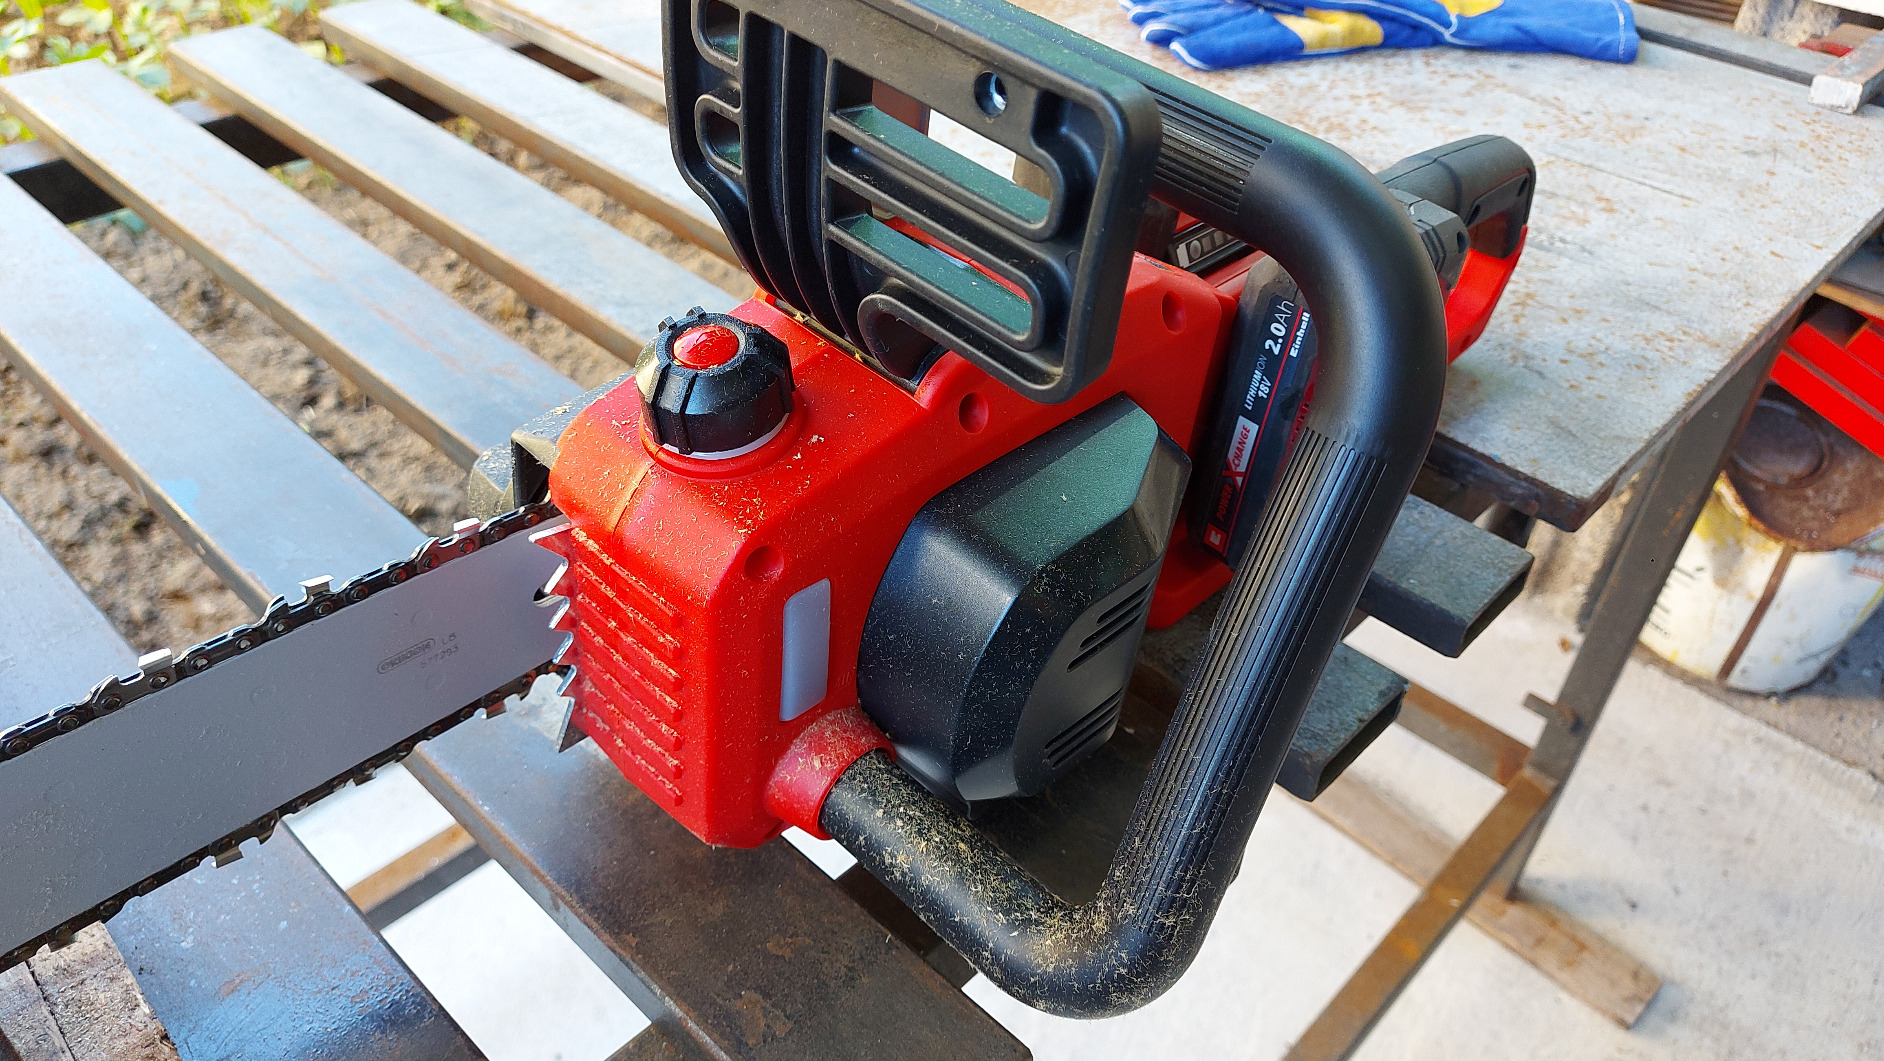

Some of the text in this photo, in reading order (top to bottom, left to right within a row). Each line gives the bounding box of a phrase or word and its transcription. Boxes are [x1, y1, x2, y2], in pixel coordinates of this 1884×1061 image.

[1264, 300, 1294, 355] 2.0Ah
[1289, 311, 1310, 357] Einhell
[1258, 375, 1271, 399] 18V
[1216, 484, 1233, 521] POWER
